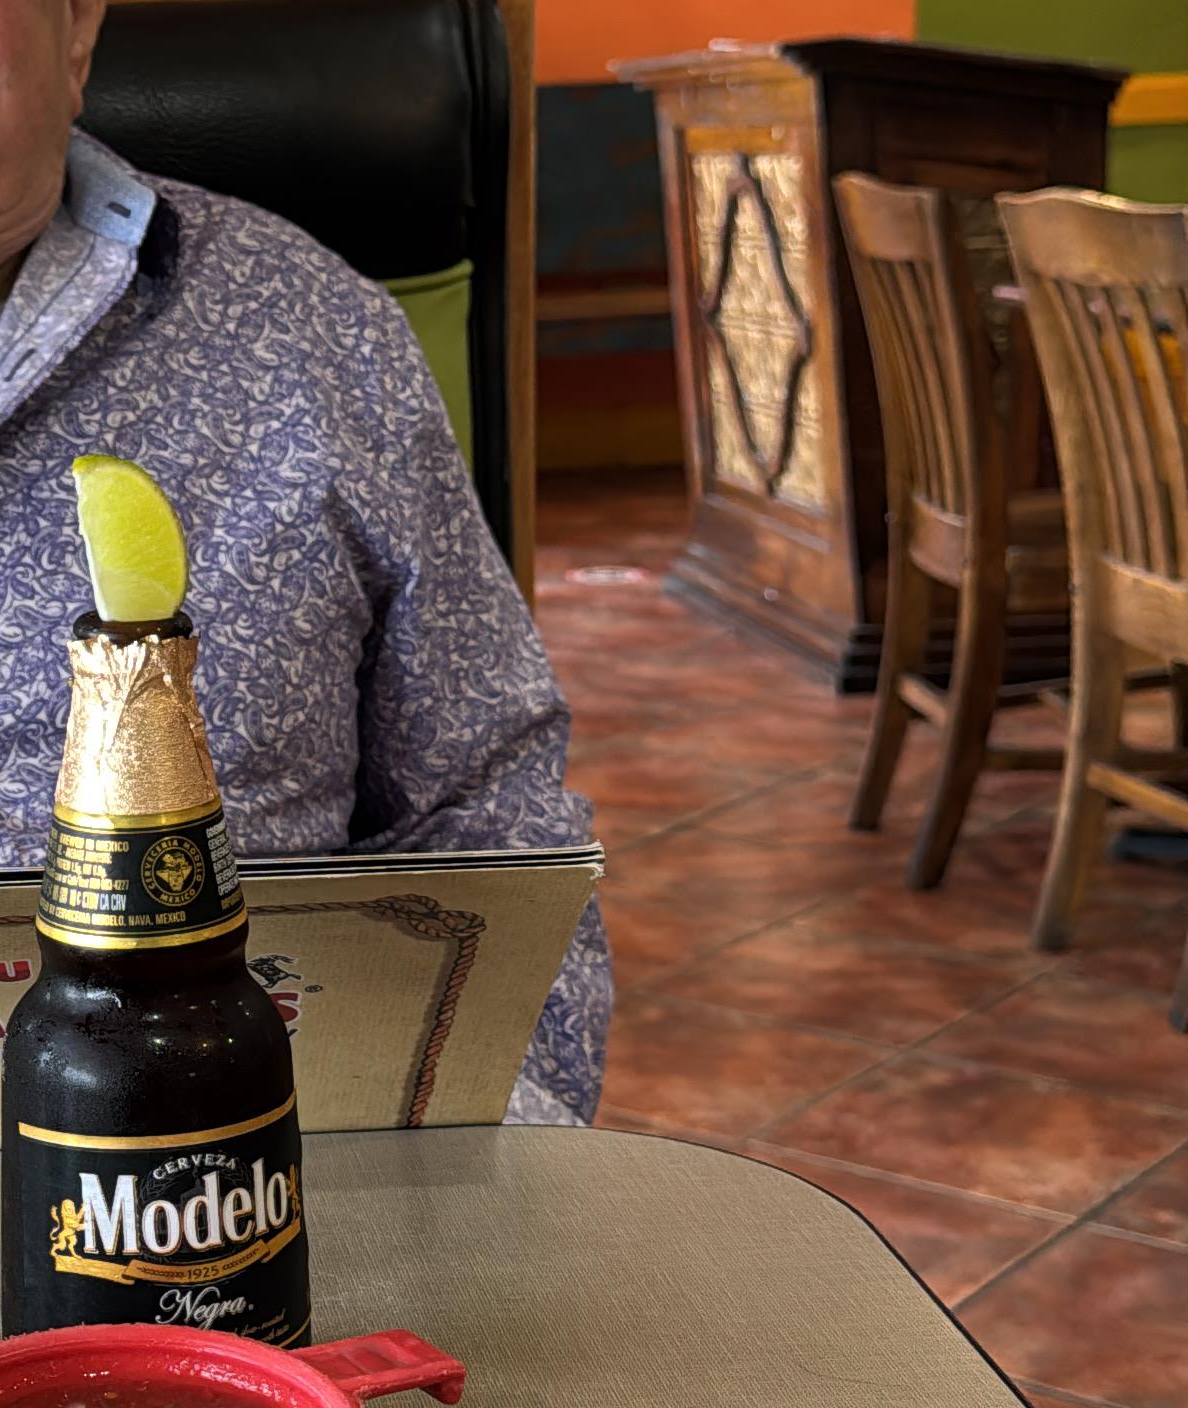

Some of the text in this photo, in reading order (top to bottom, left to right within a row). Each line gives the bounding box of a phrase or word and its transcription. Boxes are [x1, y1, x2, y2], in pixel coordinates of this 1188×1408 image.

[159, 888, 196, 903] MEXICO
[155, 911, 187, 925] MEXICO
[152, 1152, 237, 1181] CERVEZA
[78, 1156, 289, 1257] Modelo
[186, 1264, 220, 1281] 1925
